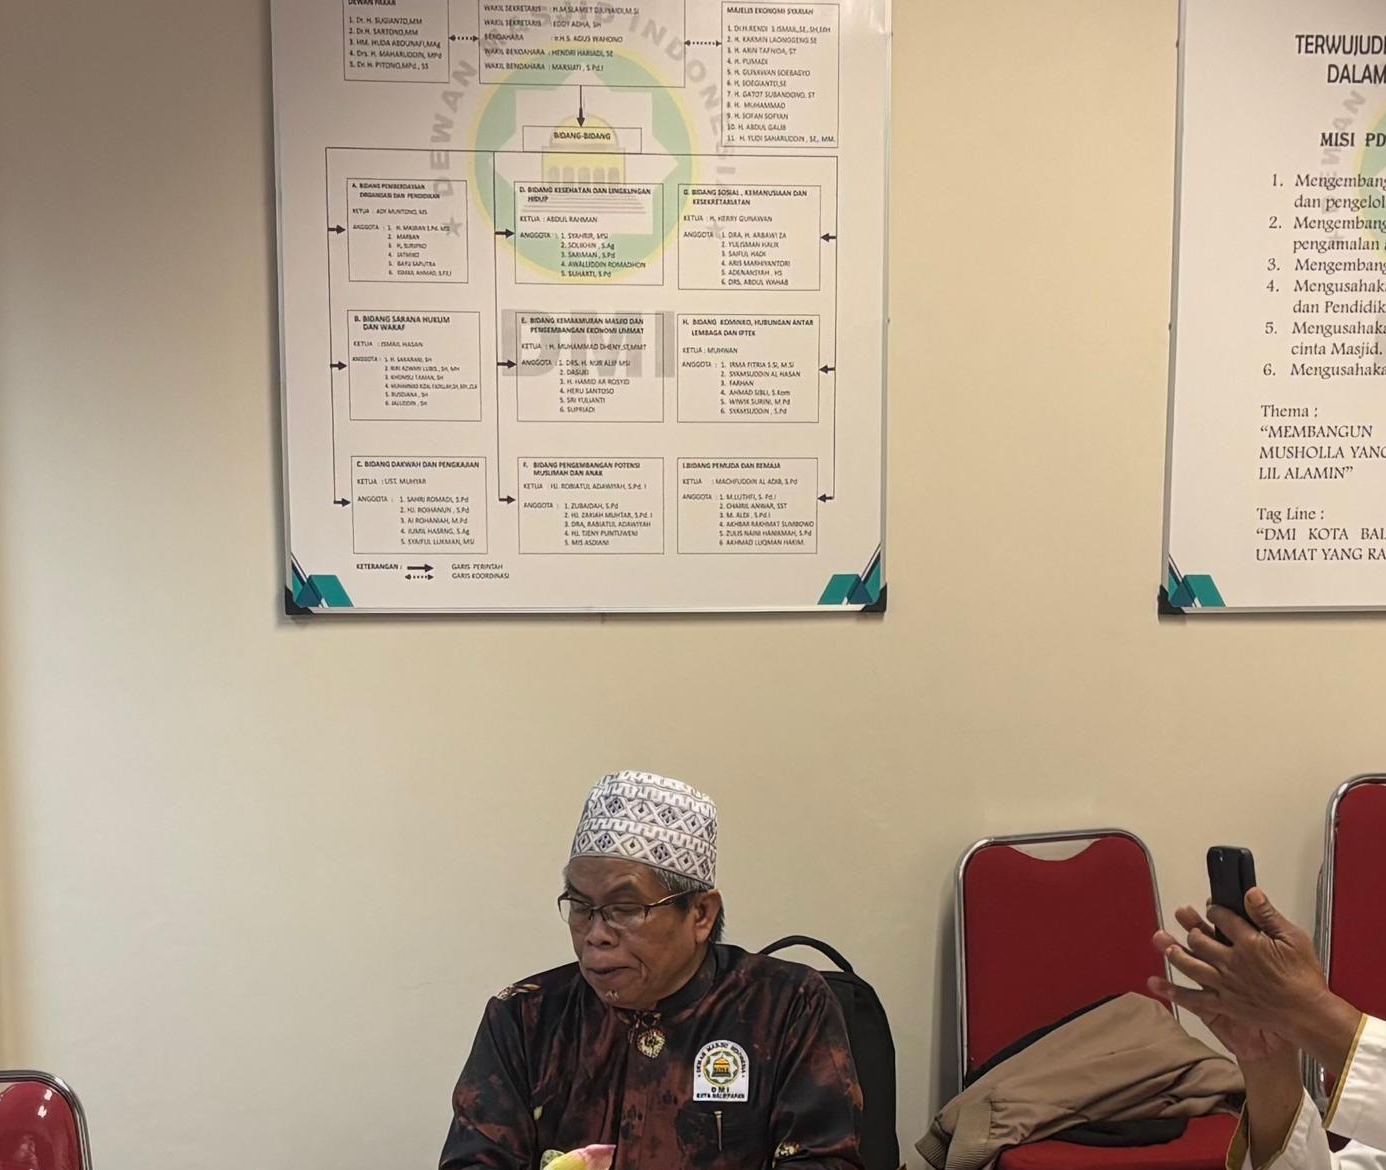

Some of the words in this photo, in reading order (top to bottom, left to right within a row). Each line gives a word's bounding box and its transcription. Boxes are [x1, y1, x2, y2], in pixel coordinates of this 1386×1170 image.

[1327, 65, 1386, 84] DALAM
[1320, 133, 1354, 147] MISI
[1365, 133, 1386, 147] PD
[1272, 175, 1283, 188] 1.
[1294, 194, 1321, 210] dan
[1269, 217, 1282, 230] 2.
[1293, 237, 1379, 254] pengamalan
[1267, 259, 1281, 272] 3.
[1267, 280, 1279, 294] 4.
[1293, 300, 1320, 314] dan
[1265, 322, 1277, 335] 5.
[1291, 342, 1327, 356] cinta
[1331, 342, 1383, 358] Masjid.
[1263, 364, 1276, 377] 6.
[1261, 404, 1309, 418] Thema
[1261, 424, 1373, 438] “MEMBANGUN
[1259, 446, 1345, 460] MUSHOLLA
[1259, 466, 1281, 480] LIL
[1285, 466, 1353, 480] ALAMIN”
[1257, 508, 1282, 524] Tag
[1287, 508, 1316, 521] Line
[1256, 527, 1297, 540] “DMI
[1309, 528, 1349, 540] KOTA
[1255, 548, 1317, 561] UMMAT
[1322, 548, 1363, 561] YANG
